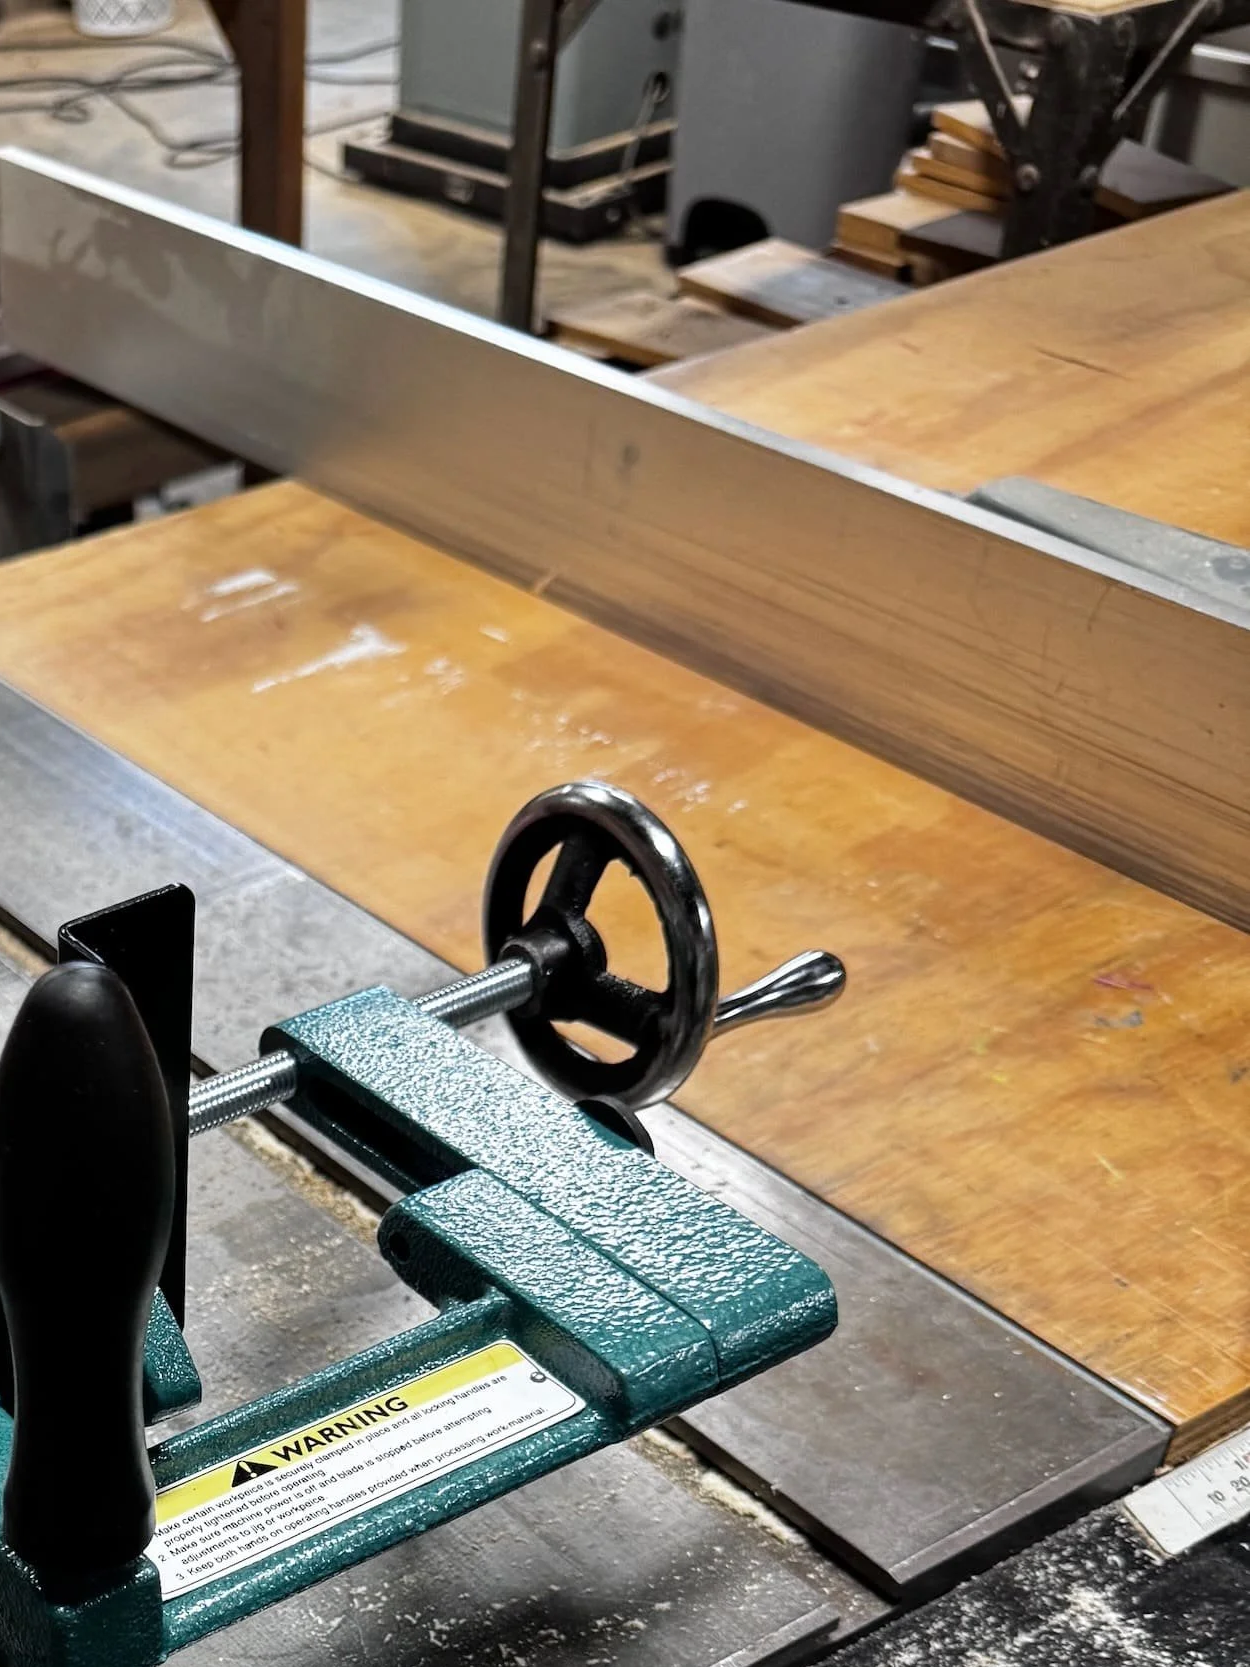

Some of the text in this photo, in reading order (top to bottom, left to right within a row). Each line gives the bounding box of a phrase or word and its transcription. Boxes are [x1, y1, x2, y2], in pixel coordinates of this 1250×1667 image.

[154, 1522, 181, 1538] Make
[181, 1506, 216, 1525] certain
[263, 1479, 275, 1487] is
[274, 1461, 314, 1482] securely
[314, 1442, 355, 1464] clamped
[353, 1438, 365, 1446] in
[365, 1426, 391, 1443] place
[391, 1417, 410, 1430] and
[410, 1411, 423, 1421] all
[421, 1398, 456, 1415] locking
[453, 1382, 491, 1401] handles
[491, 1375, 508, 1385] are
[270, 1396, 409, 1462] WARNING
[169, 1541, 198, 1557] Make
[198, 1530, 222, 1544] sure
[222, 1511, 263, 1533] machine
[263, 1496, 293, 1515] power
[304, 1484, 318, 1495] off
[318, 1475, 338, 1488] and
[336, 1464, 365, 1480] blade
[364, 1459, 375, 1467] is
[374, 1440, 413, 1463] stopped
[411, 1428, 443, 1445] before
[442, 1407, 492, 1431] attempting
[186, 1561, 214, 1576] Keep
[213, 1549, 239, 1564] both
[236, 1535, 269, 1552] hands
[269, 1528, 284, 1538] on
[284, 1507, 330, 1531] operating
[367, 1469, 409, 1494] provided
[408, 1458, 435, 1473] when
[434, 1435, 486, 1463] processing
[1207, 1476, 1250, 1504] 10 20
[163, 1524, 204, 1548] properly
[203, 1502, 250, 1528] tightened
[247, 1489, 280, 1507] before
[181, 1534, 240, 1565] adjustments
[238, 1529, 251, 1538] to
[250, 1523, 266, 1534] jig
[264, 1517, 276, 1526] or
